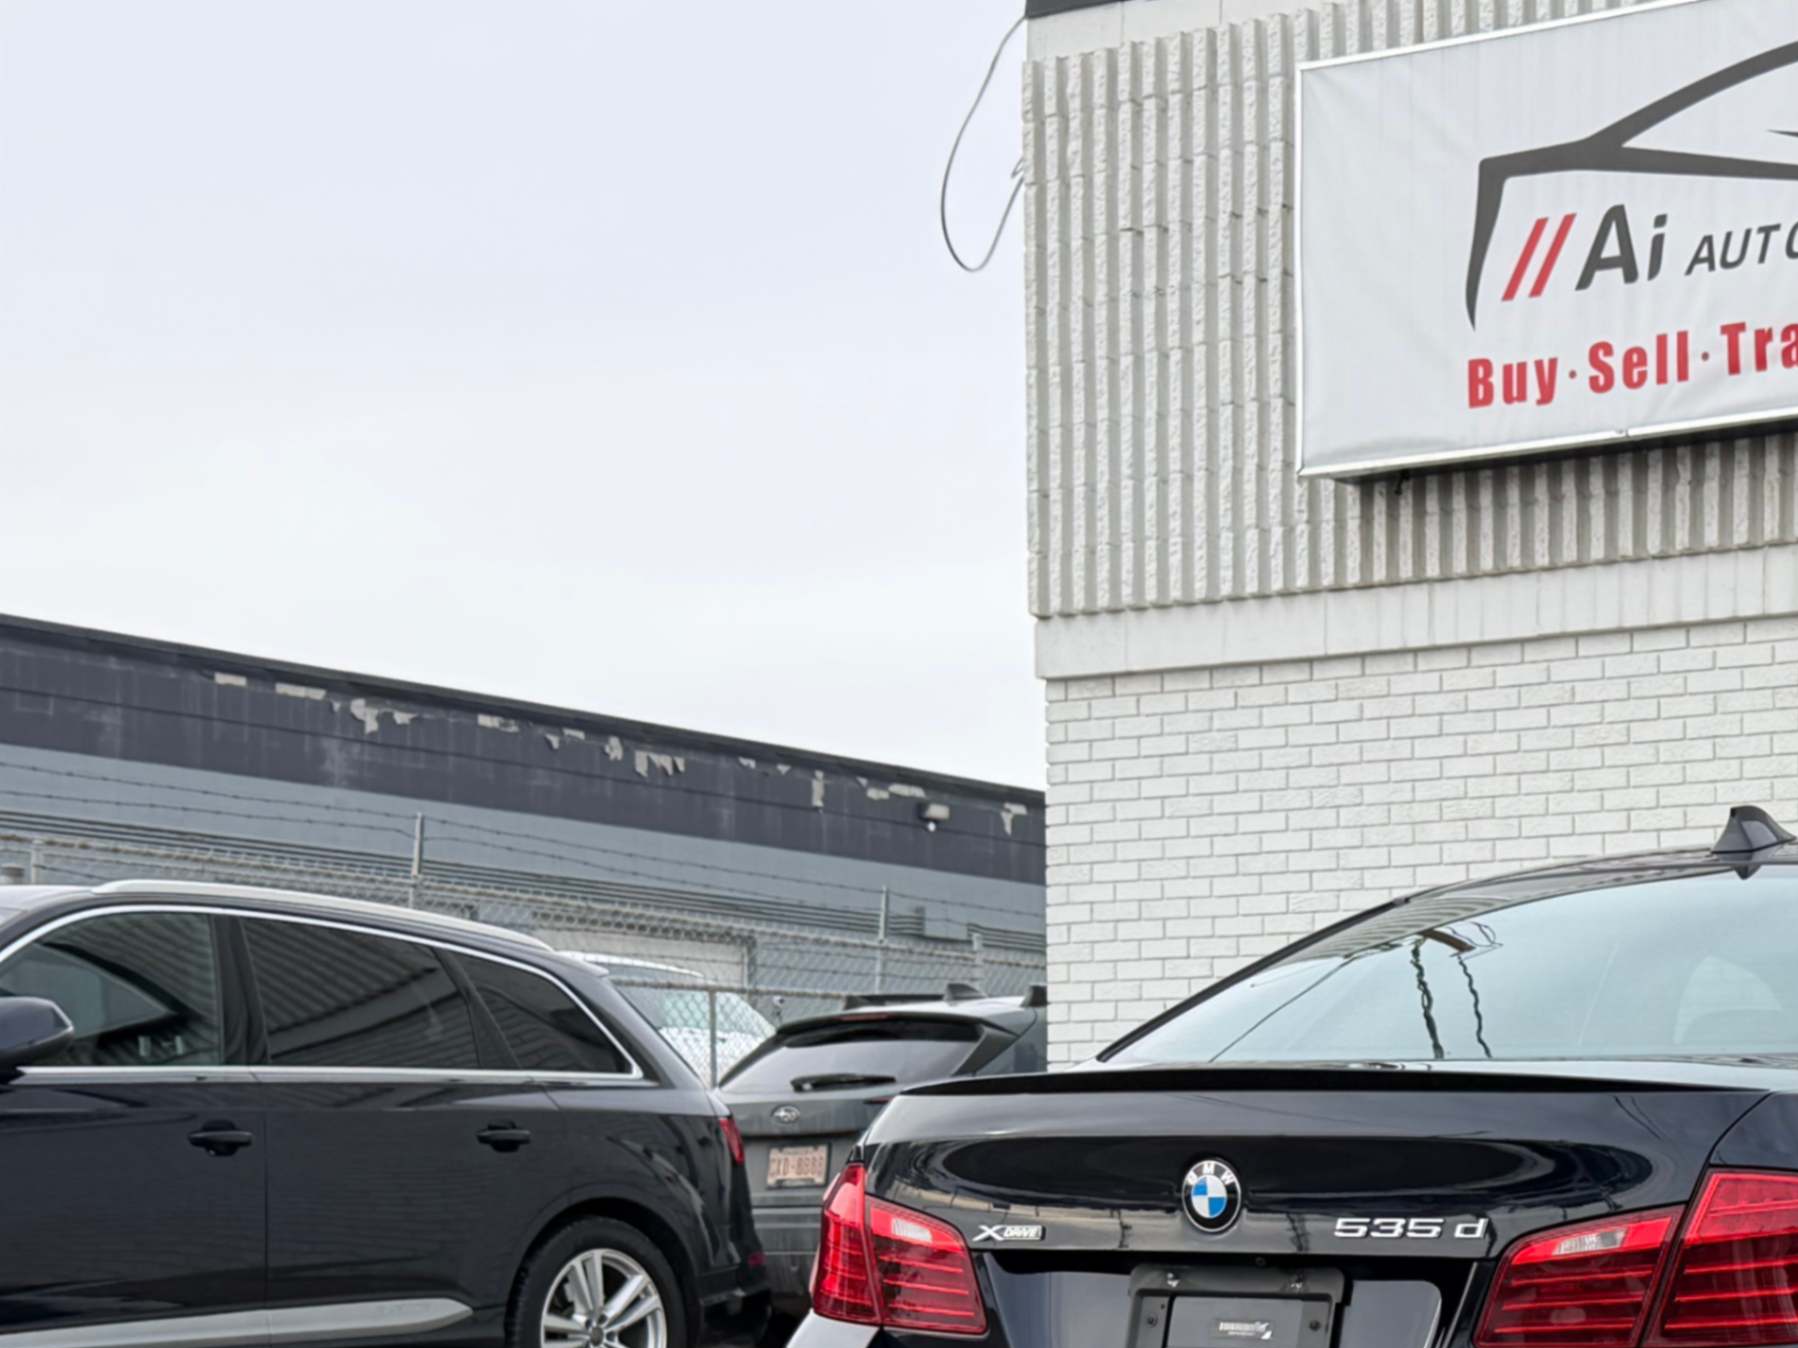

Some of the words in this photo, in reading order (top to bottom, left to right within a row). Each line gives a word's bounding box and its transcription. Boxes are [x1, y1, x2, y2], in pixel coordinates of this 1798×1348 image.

[1575, 204, 1668, 291] Ai
[1467, 358, 1558, 409] Buy
[1588, 330, 1690, 394] Sell
[1187, 1161, 1238, 1186] BMW
